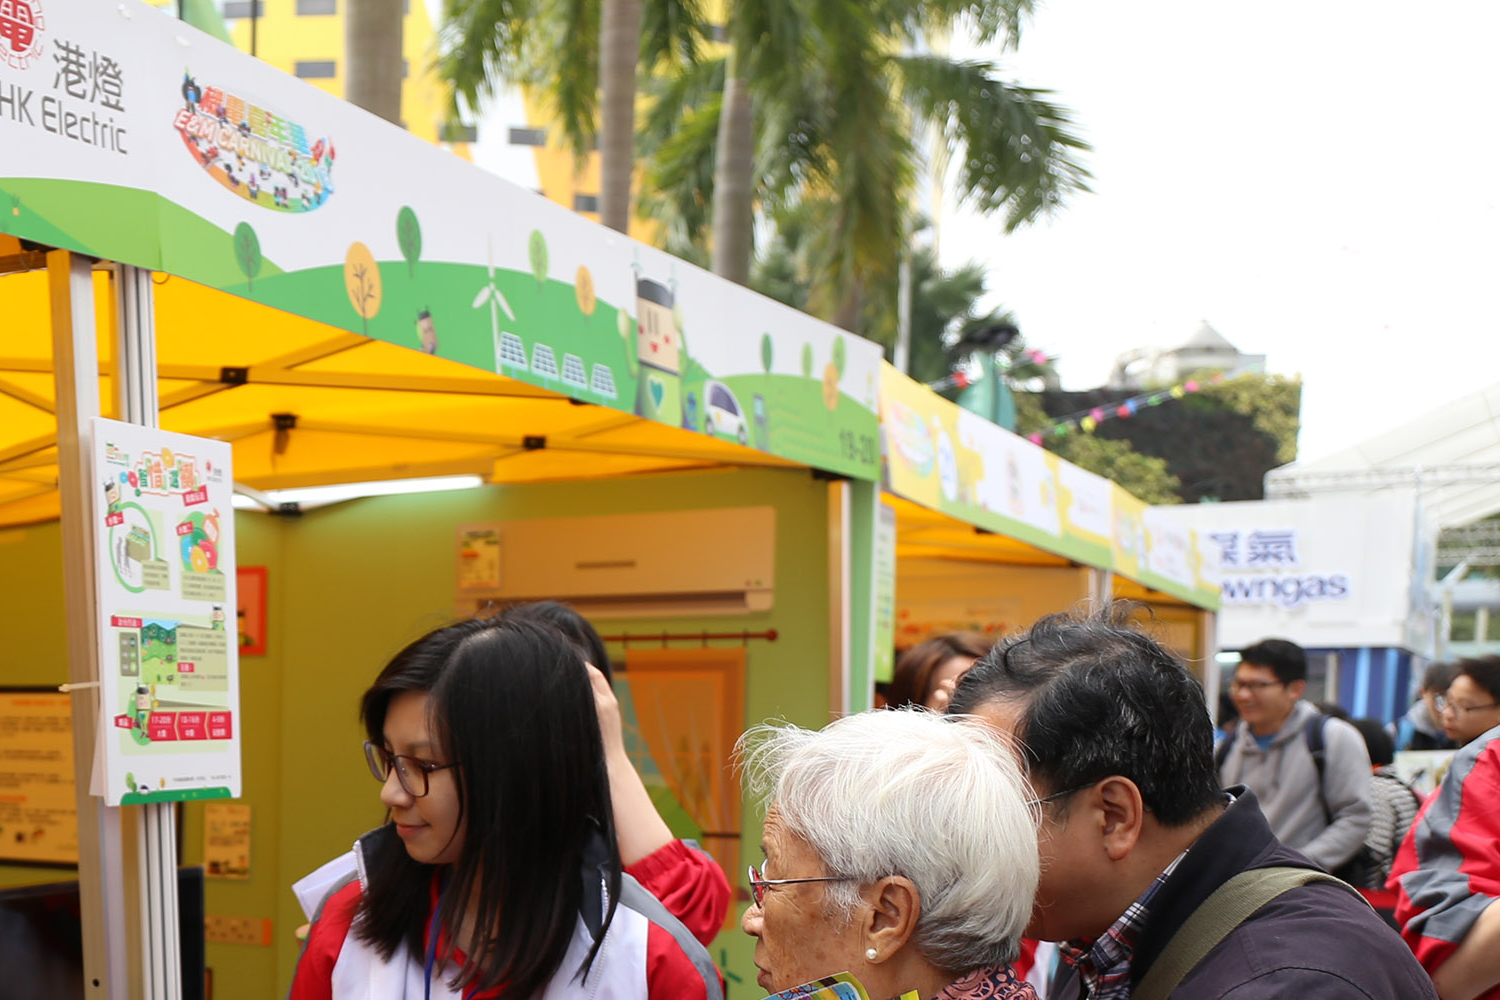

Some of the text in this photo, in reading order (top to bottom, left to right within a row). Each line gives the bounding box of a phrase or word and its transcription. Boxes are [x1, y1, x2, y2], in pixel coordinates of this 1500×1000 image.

[53, 39, 125, 112] 港燈
[41, 95, 127, 155] Electric
[174, 109, 301, 176] E&M CARNIVAL
